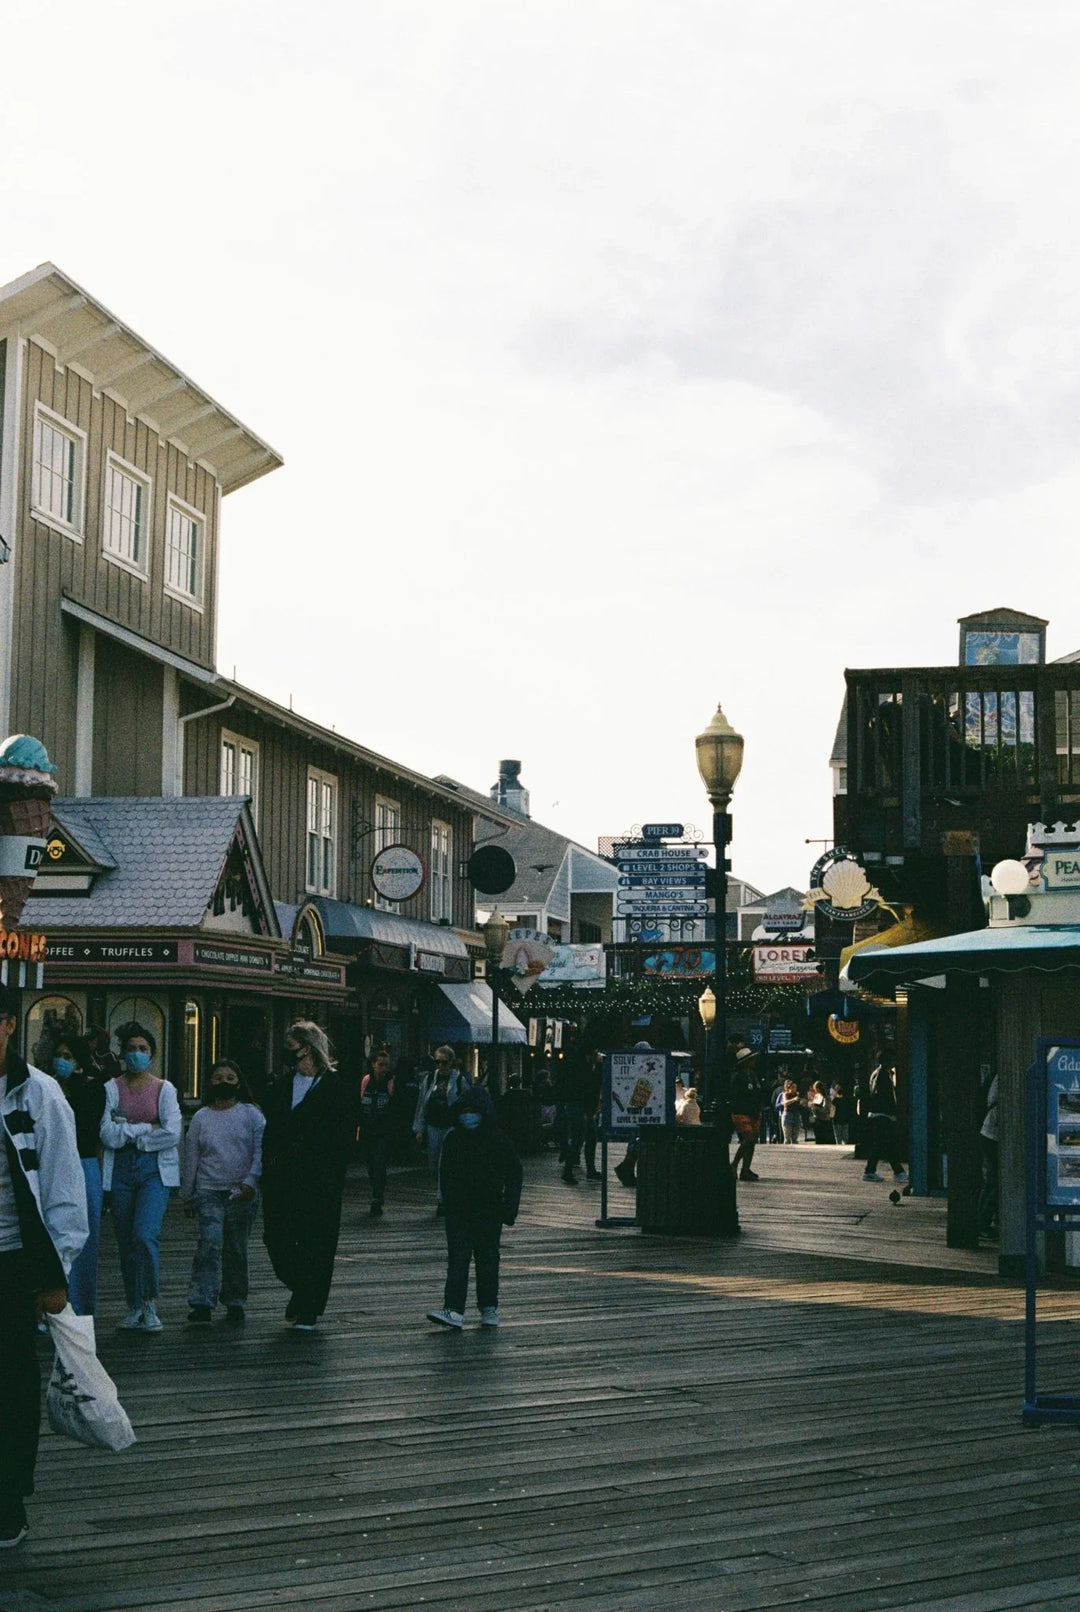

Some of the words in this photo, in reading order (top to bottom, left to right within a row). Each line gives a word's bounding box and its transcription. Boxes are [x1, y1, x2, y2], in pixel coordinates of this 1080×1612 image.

[647, 826, 669, 836] PIER
[669, 826, 680, 836] 39
[29, 850, 42, 866] D
[637, 850, 659, 858] CRAB
[661, 850, 691, 858] HOUSE
[633, 863, 657, 871] LEVEL
[660, 863, 668, 871] 2
[669, 863, 696, 871] SHOPS
[812, 863, 822, 881] THE
[645, 891, 684, 899] MANGO'S
[0, 931, 47, 962] CONES
[101, 947, 153, 957] TRUFFLES
[613, 1055, 636, 1065] SOLVE
